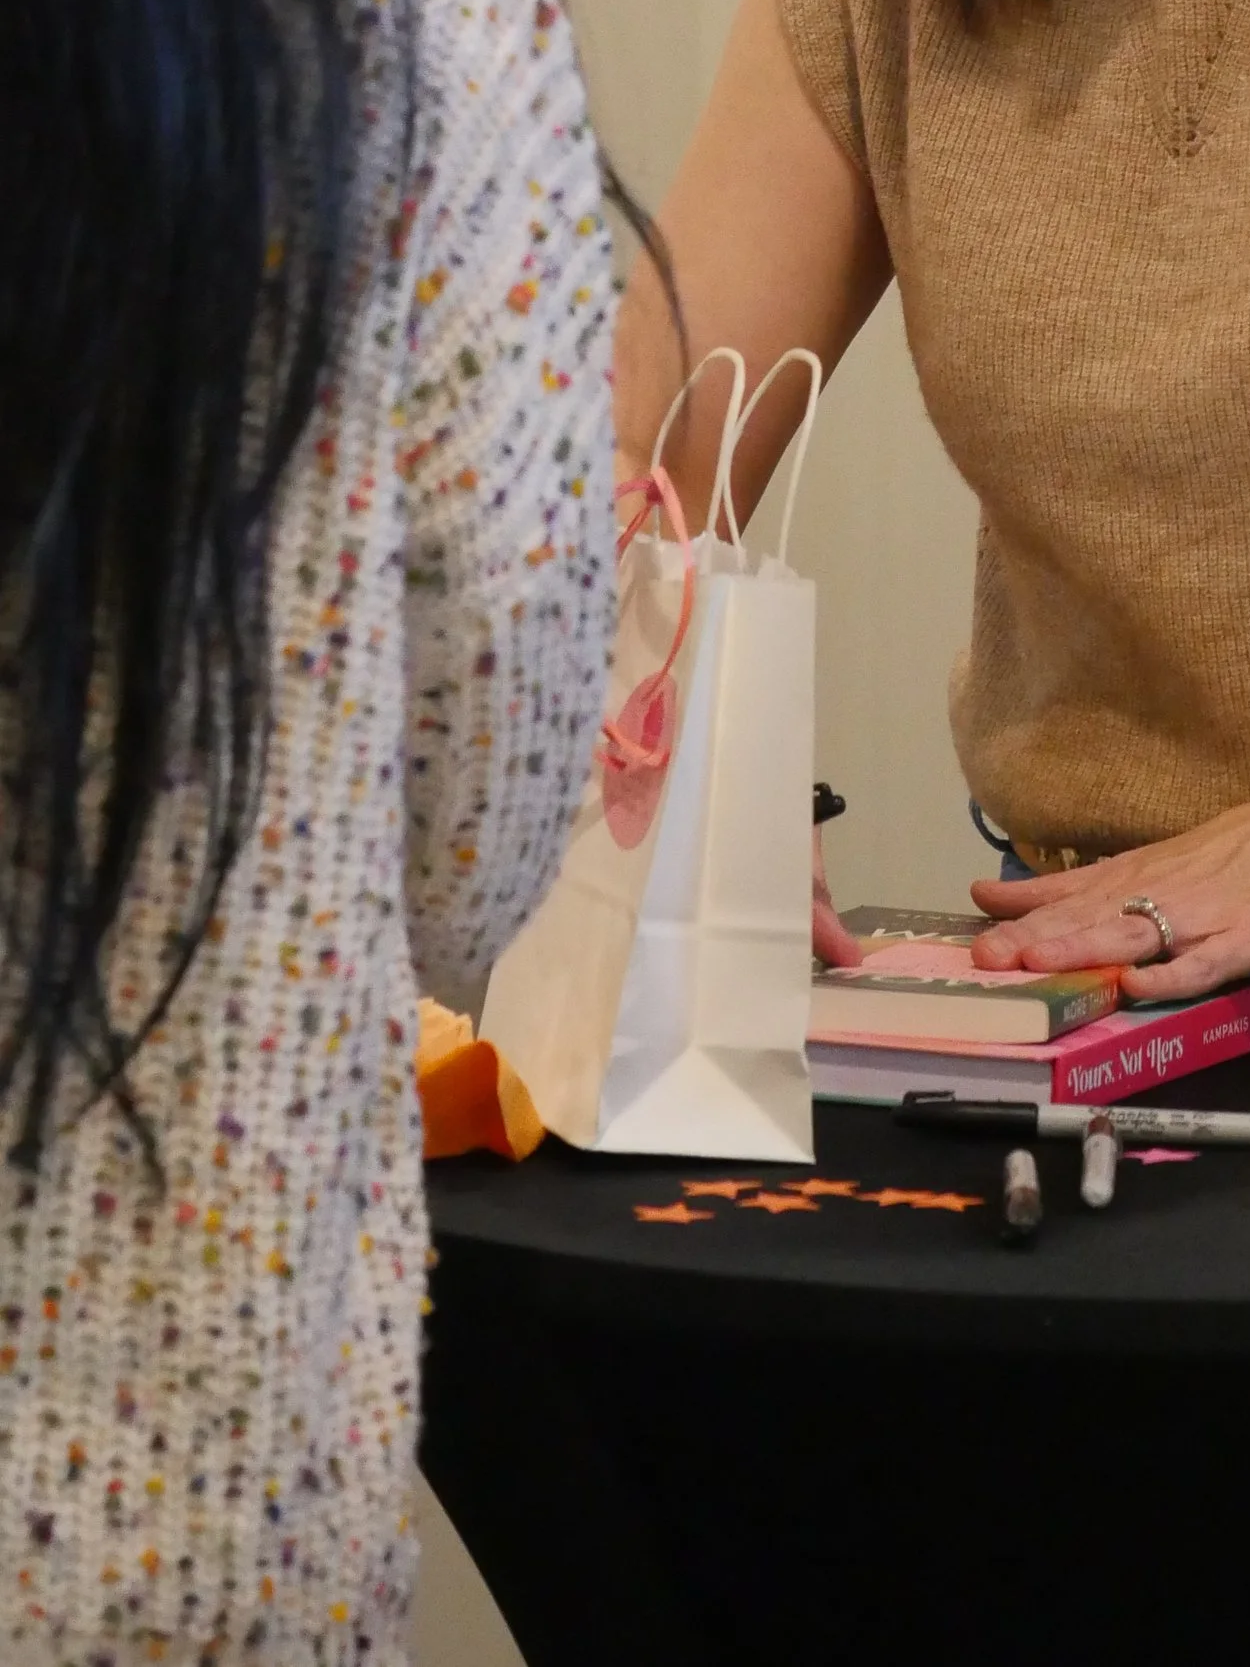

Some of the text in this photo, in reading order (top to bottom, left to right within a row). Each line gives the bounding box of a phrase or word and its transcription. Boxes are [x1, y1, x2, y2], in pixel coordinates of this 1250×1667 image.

[1202, 1016, 1250, 1045] KAMPAKIS
[1117, 1045, 1143, 1080] Not
[1146, 1035, 1184, 1077] Hers
